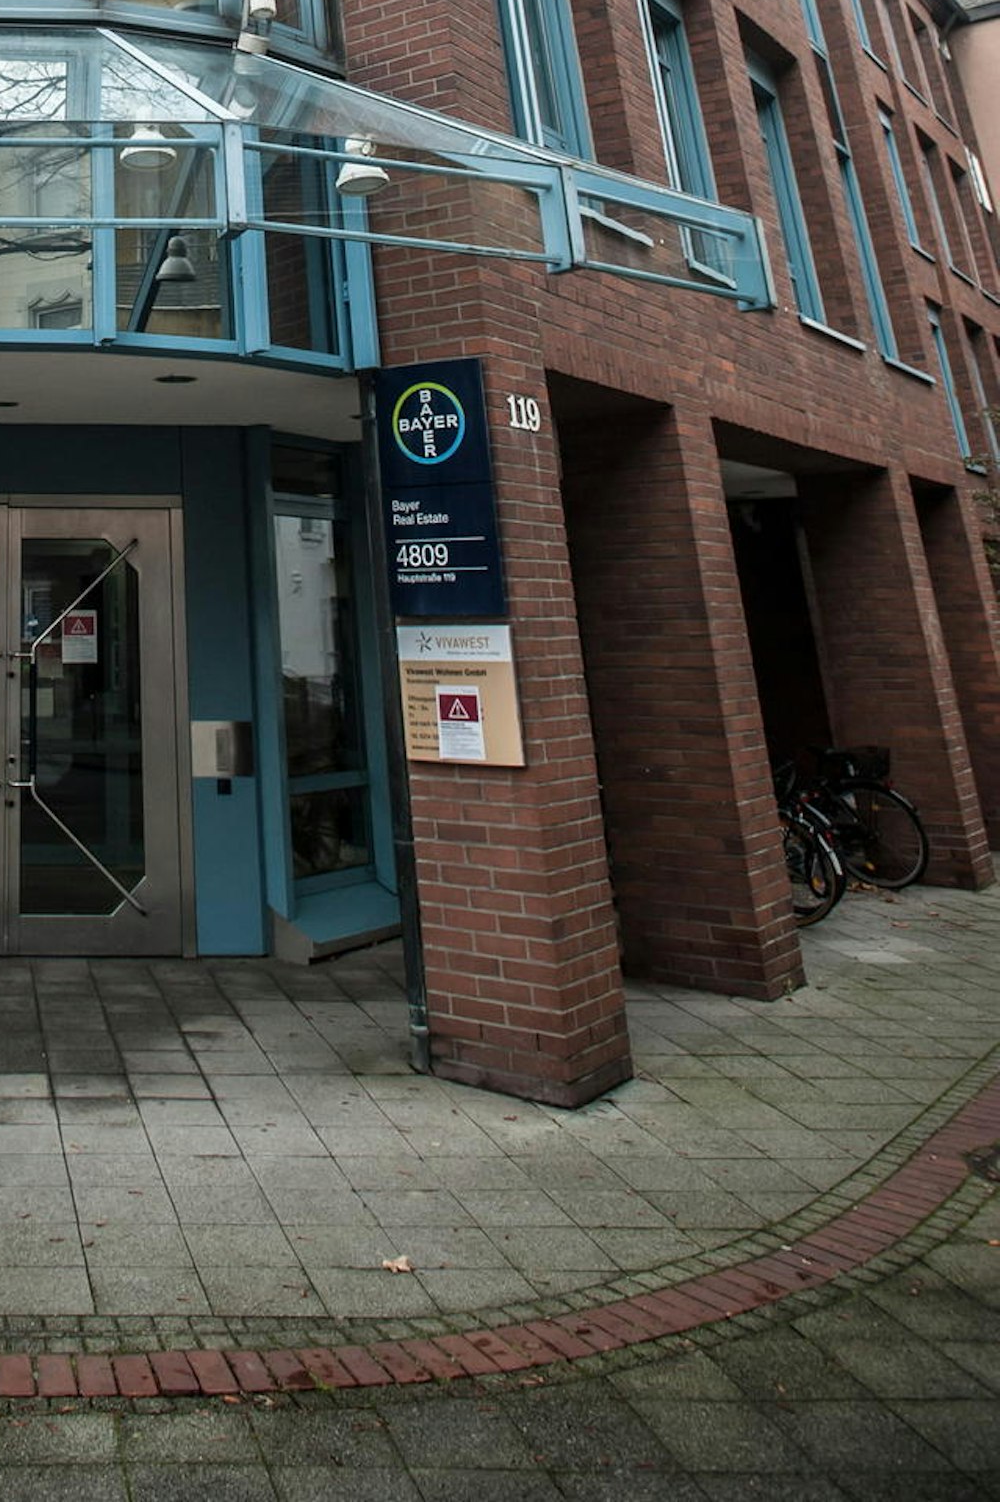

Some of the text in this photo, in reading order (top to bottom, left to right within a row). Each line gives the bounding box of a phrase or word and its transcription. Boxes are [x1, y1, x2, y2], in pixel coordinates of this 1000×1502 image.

[507, 394, 541, 432] 119
[399, 414, 458, 433] BAYER
[418, 389, 437, 458] BAYER
[391, 499, 420, 514] Bayer
[393, 513, 449, 526] Real Estate
[396, 543, 449, 567] 4809
[435, 636, 490, 650] VIVAWEST
